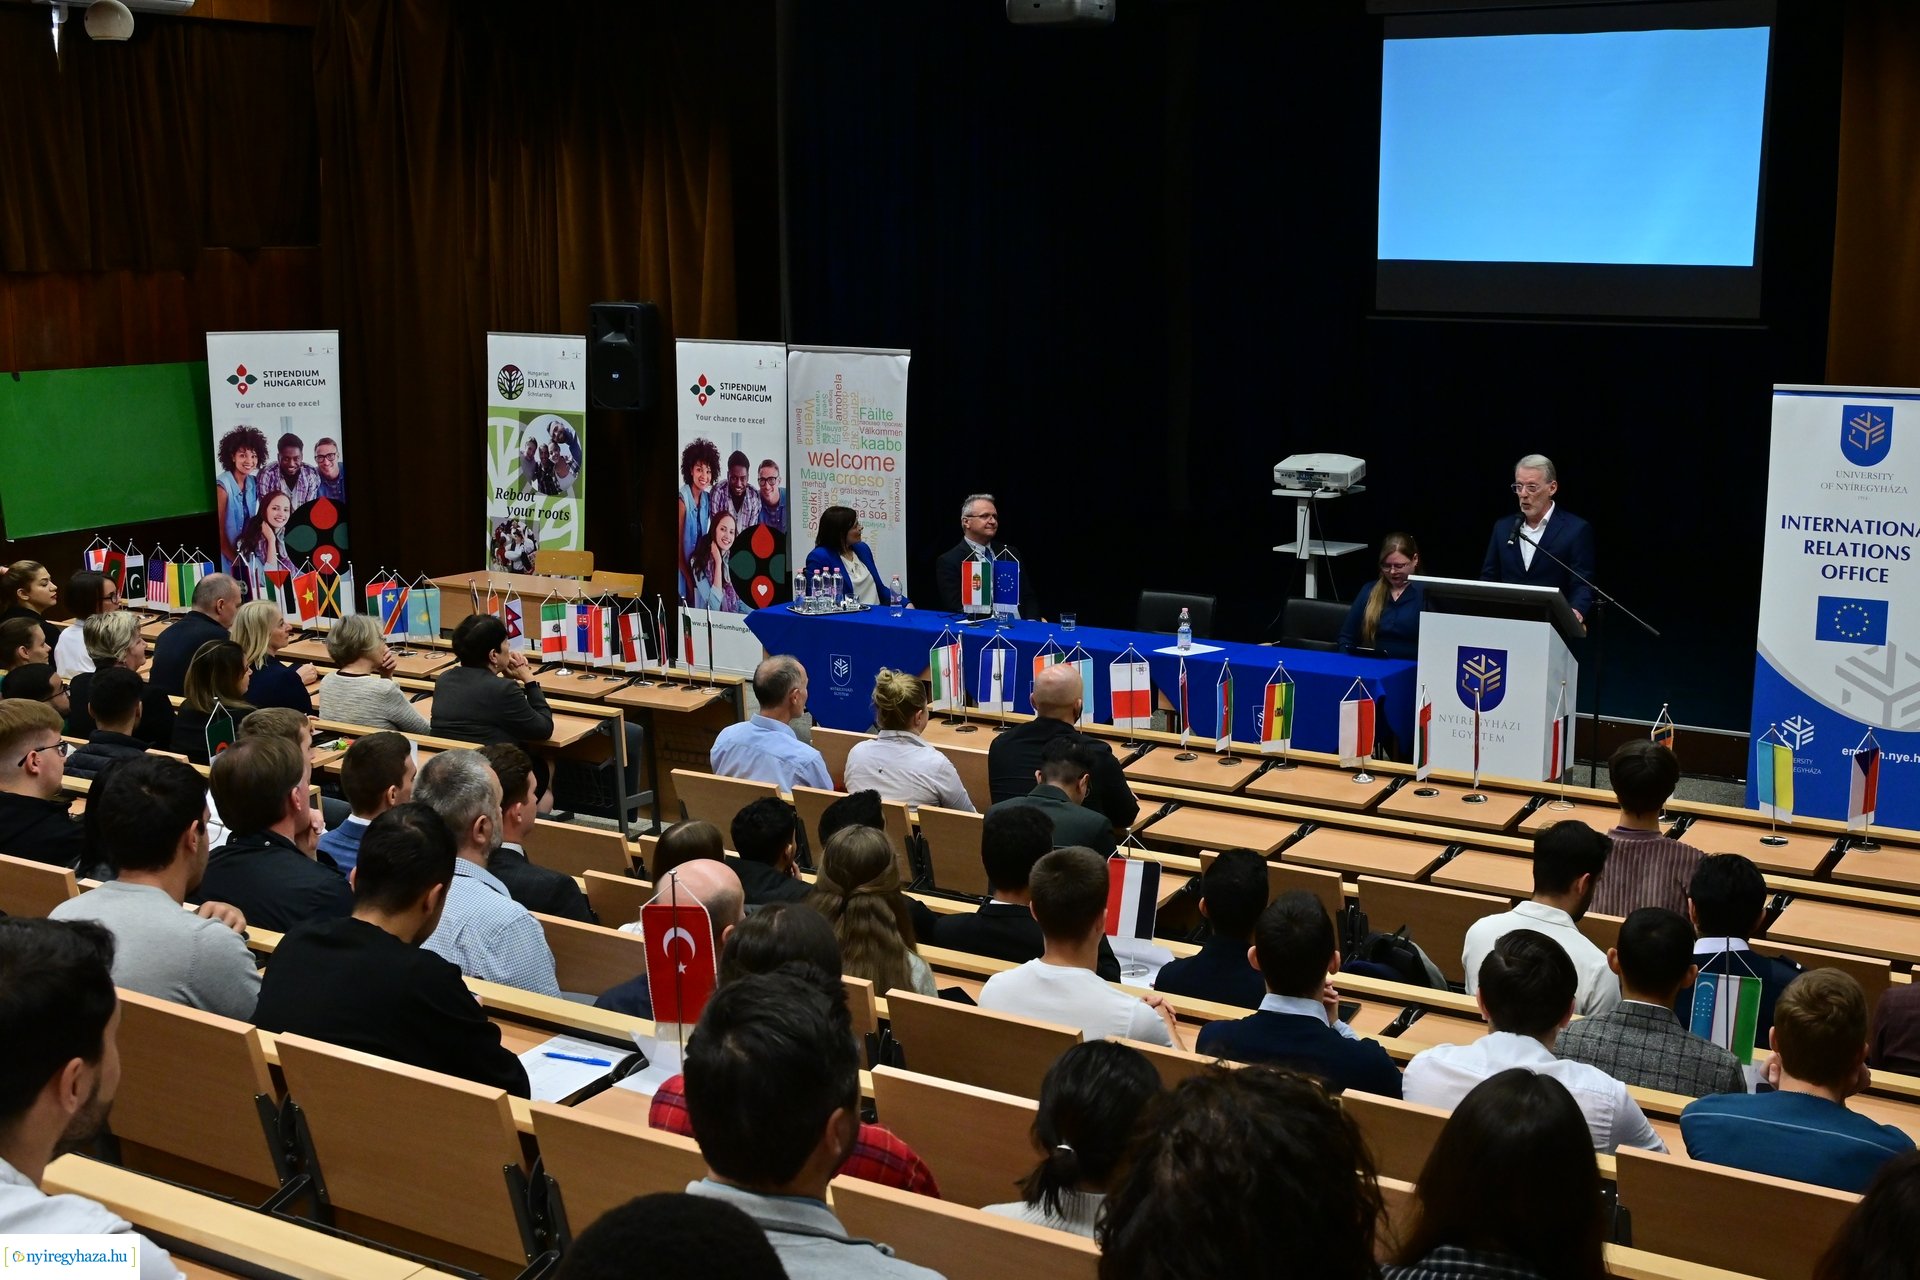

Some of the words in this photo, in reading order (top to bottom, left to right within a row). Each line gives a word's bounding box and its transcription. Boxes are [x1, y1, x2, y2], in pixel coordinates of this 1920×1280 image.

[262, 370, 320, 378] STIPENDIUM
[264, 379, 326, 388] HUNGARICUM
[528, 379, 576, 390] DIASPORA
[720, 382, 766, 392] STIPENDIUM
[720, 393, 772, 402] HUNGARICUM
[834, 374, 842, 421] amohela
[860, 407, 893, 420] Fàilte
[804, 399, 815, 446] Welina
[861, 436, 902, 451] kaabo
[808, 448, 895, 472] welcome
[800, 468, 836, 481] Mauya
[836, 473, 884, 488] croeso
[1836, 470, 1894, 481] UNIVERSITY
[840, 487, 880, 496] gratissimum
[1836, 481, 1908, 494] NYÍREGYHÁZA
[495, 487, 535, 502] Reboot
[852, 498, 887, 510] ようこそ
[506, 506, 535, 518] your
[538, 509, 570, 521] roots
[809, 492, 817, 530] Sveiki
[1804, 540, 1911, 561] RELATIONS
[1821, 564, 1889, 584] OFFICE
[1452, 729, 1505, 743] EGYTEM
